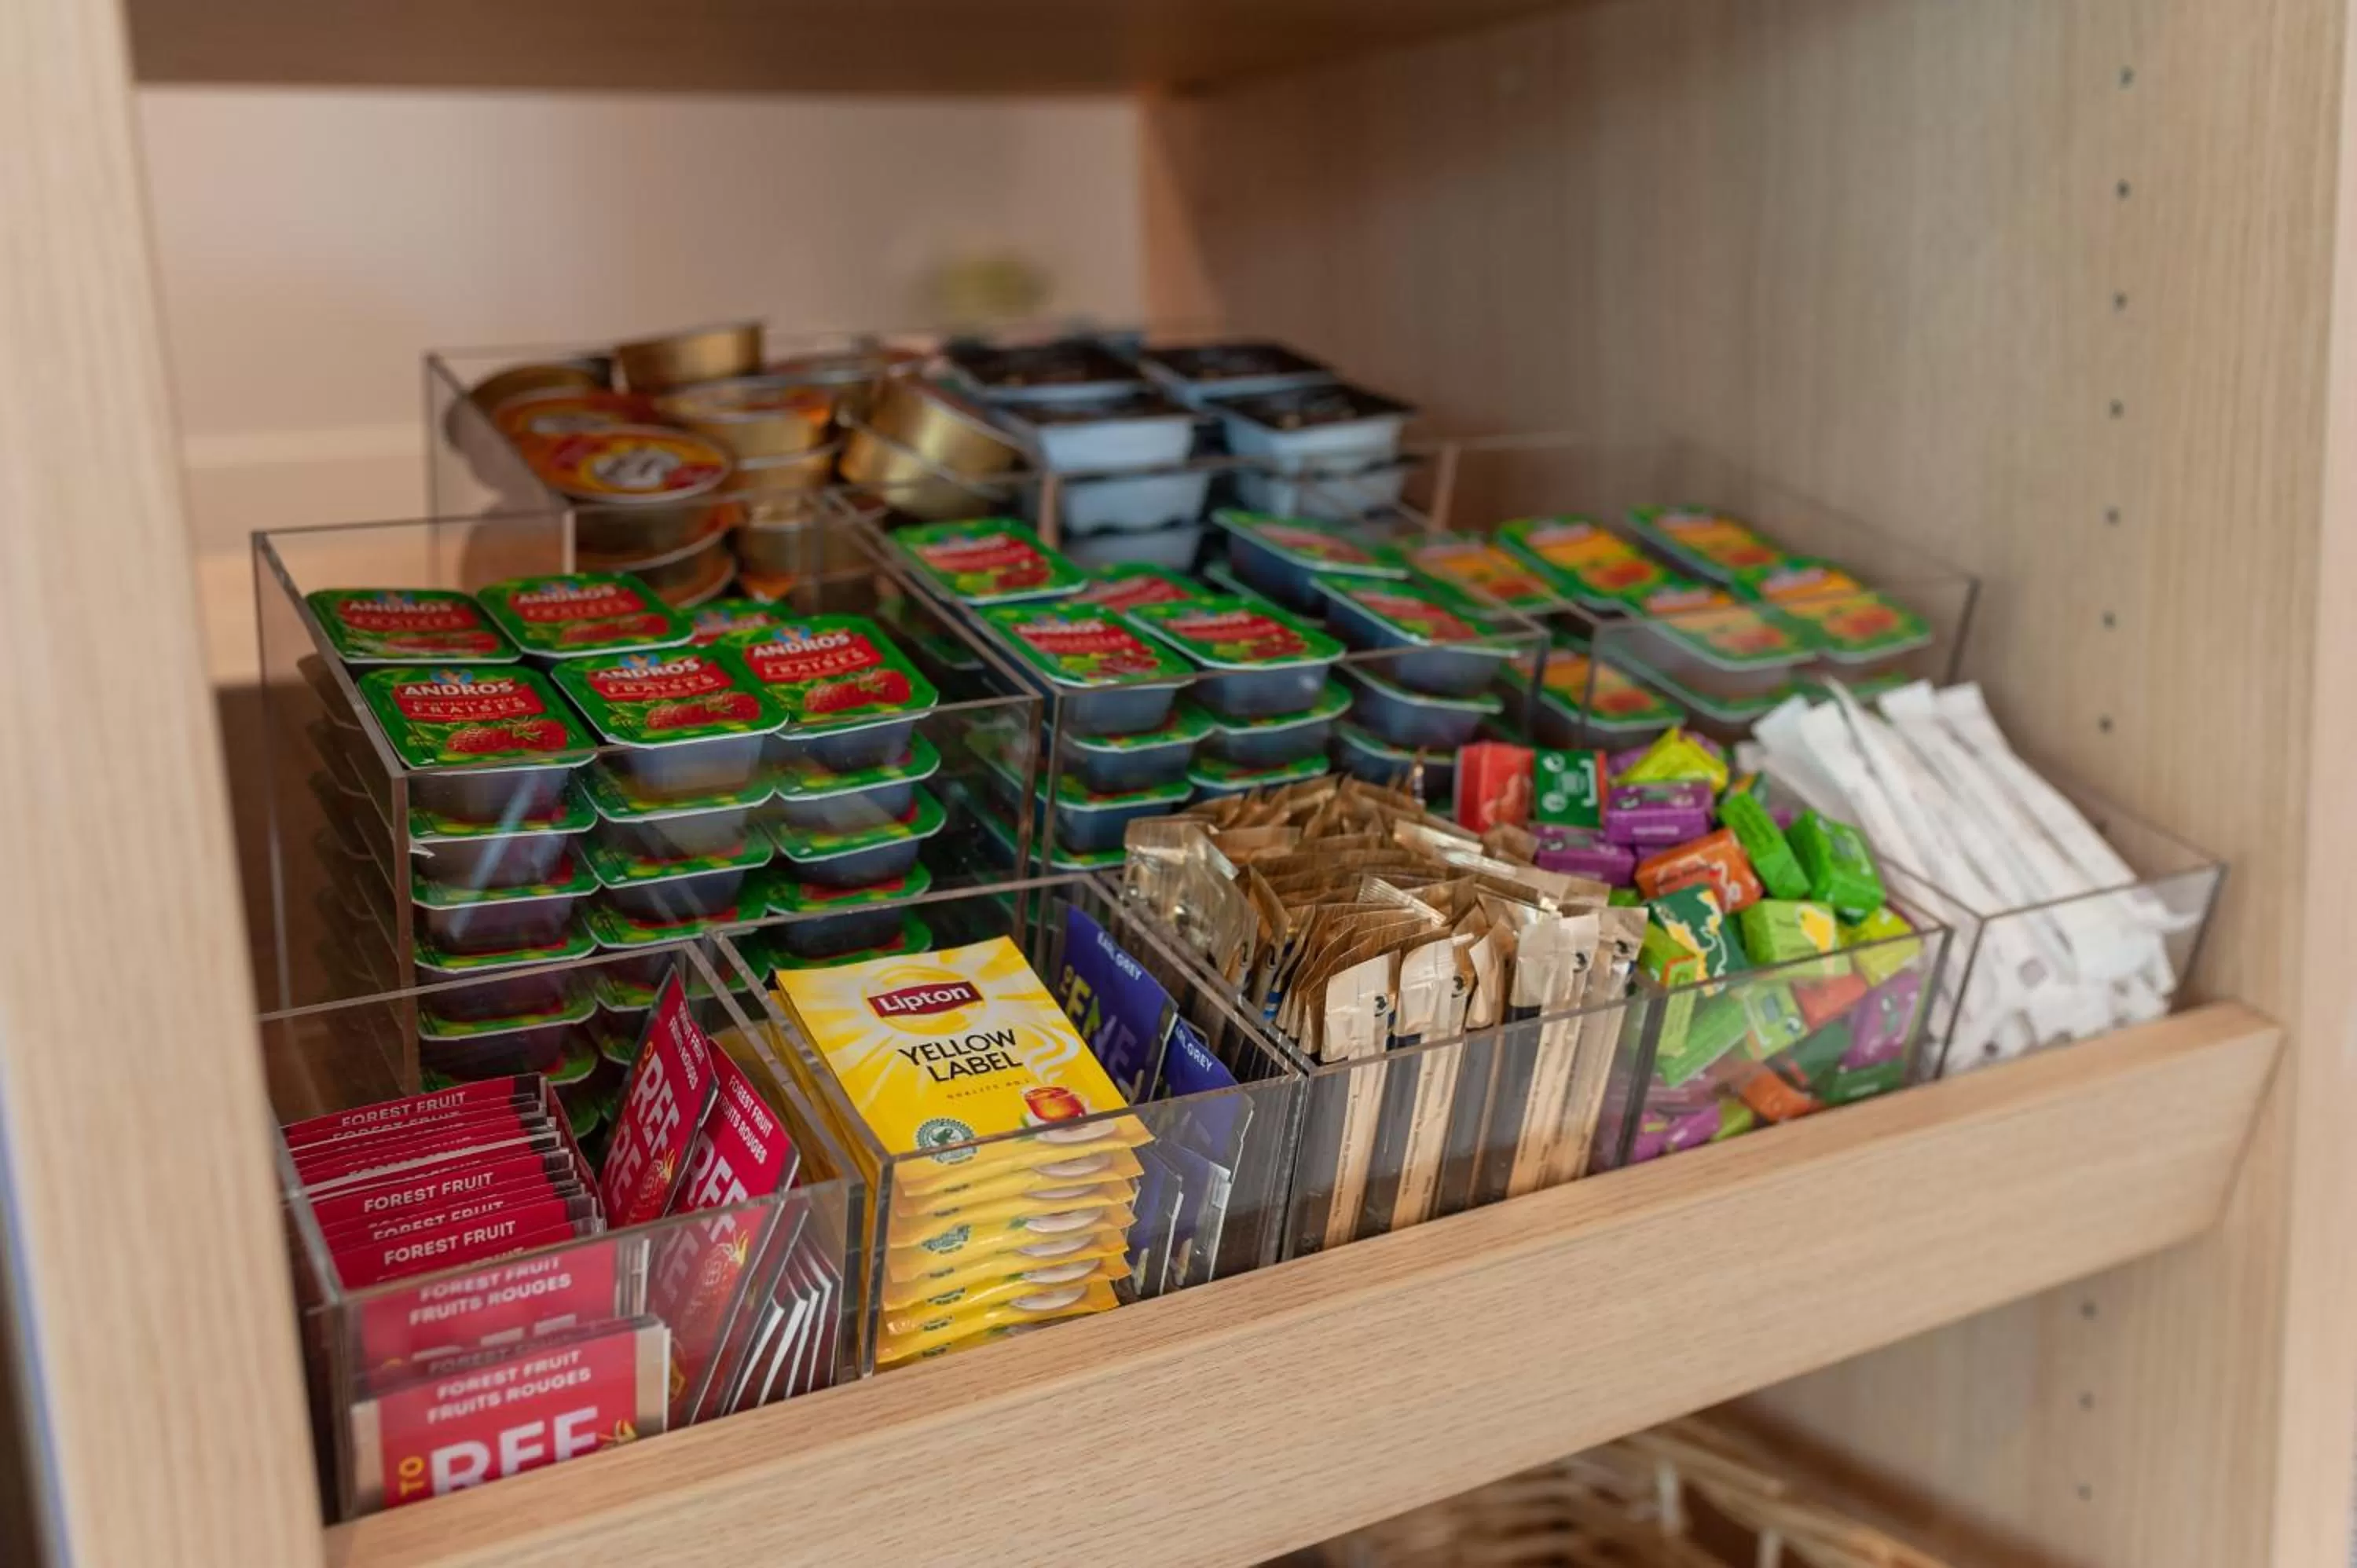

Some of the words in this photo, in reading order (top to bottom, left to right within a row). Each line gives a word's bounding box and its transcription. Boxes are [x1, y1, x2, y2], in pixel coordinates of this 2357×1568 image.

[753, 633, 850, 658] ANDROS
[598, 659, 701, 680] ANDROS
[405, 680, 514, 696] ANDROS
[1115, 952, 1142, 981] GREY
[878, 987, 971, 1012] Lipton
[897, 1028, 1017, 1066] YELLOW
[1187, 1042, 1213, 1072] GREY
[926, 1051, 1024, 1082] LABEL
[342, 1104, 412, 1127] FOREST
[416, 1091, 467, 1113] FRUIT
[750, 1108, 774, 1138] FRUIT
[736, 1120, 768, 1166] ROUGES
[364, 1185, 437, 1213] FOREST
[442, 1172, 494, 1195] FRUIT
[383, 1236, 460, 1266] FOREST
[464, 1220, 516, 1246] FRUIT
[420, 1272, 501, 1302] FOREST
[505, 1257, 561, 1281] FRUIT
[409, 1298, 483, 1326] FRUITS
[487, 1273, 572, 1306] ROUGES
[437, 1367, 519, 1400] FOREST
[523, 1349, 582, 1377] FRUIT
[427, 1390, 502, 1425] FRUITS
[505, 1366, 592, 1402] ROUGES
